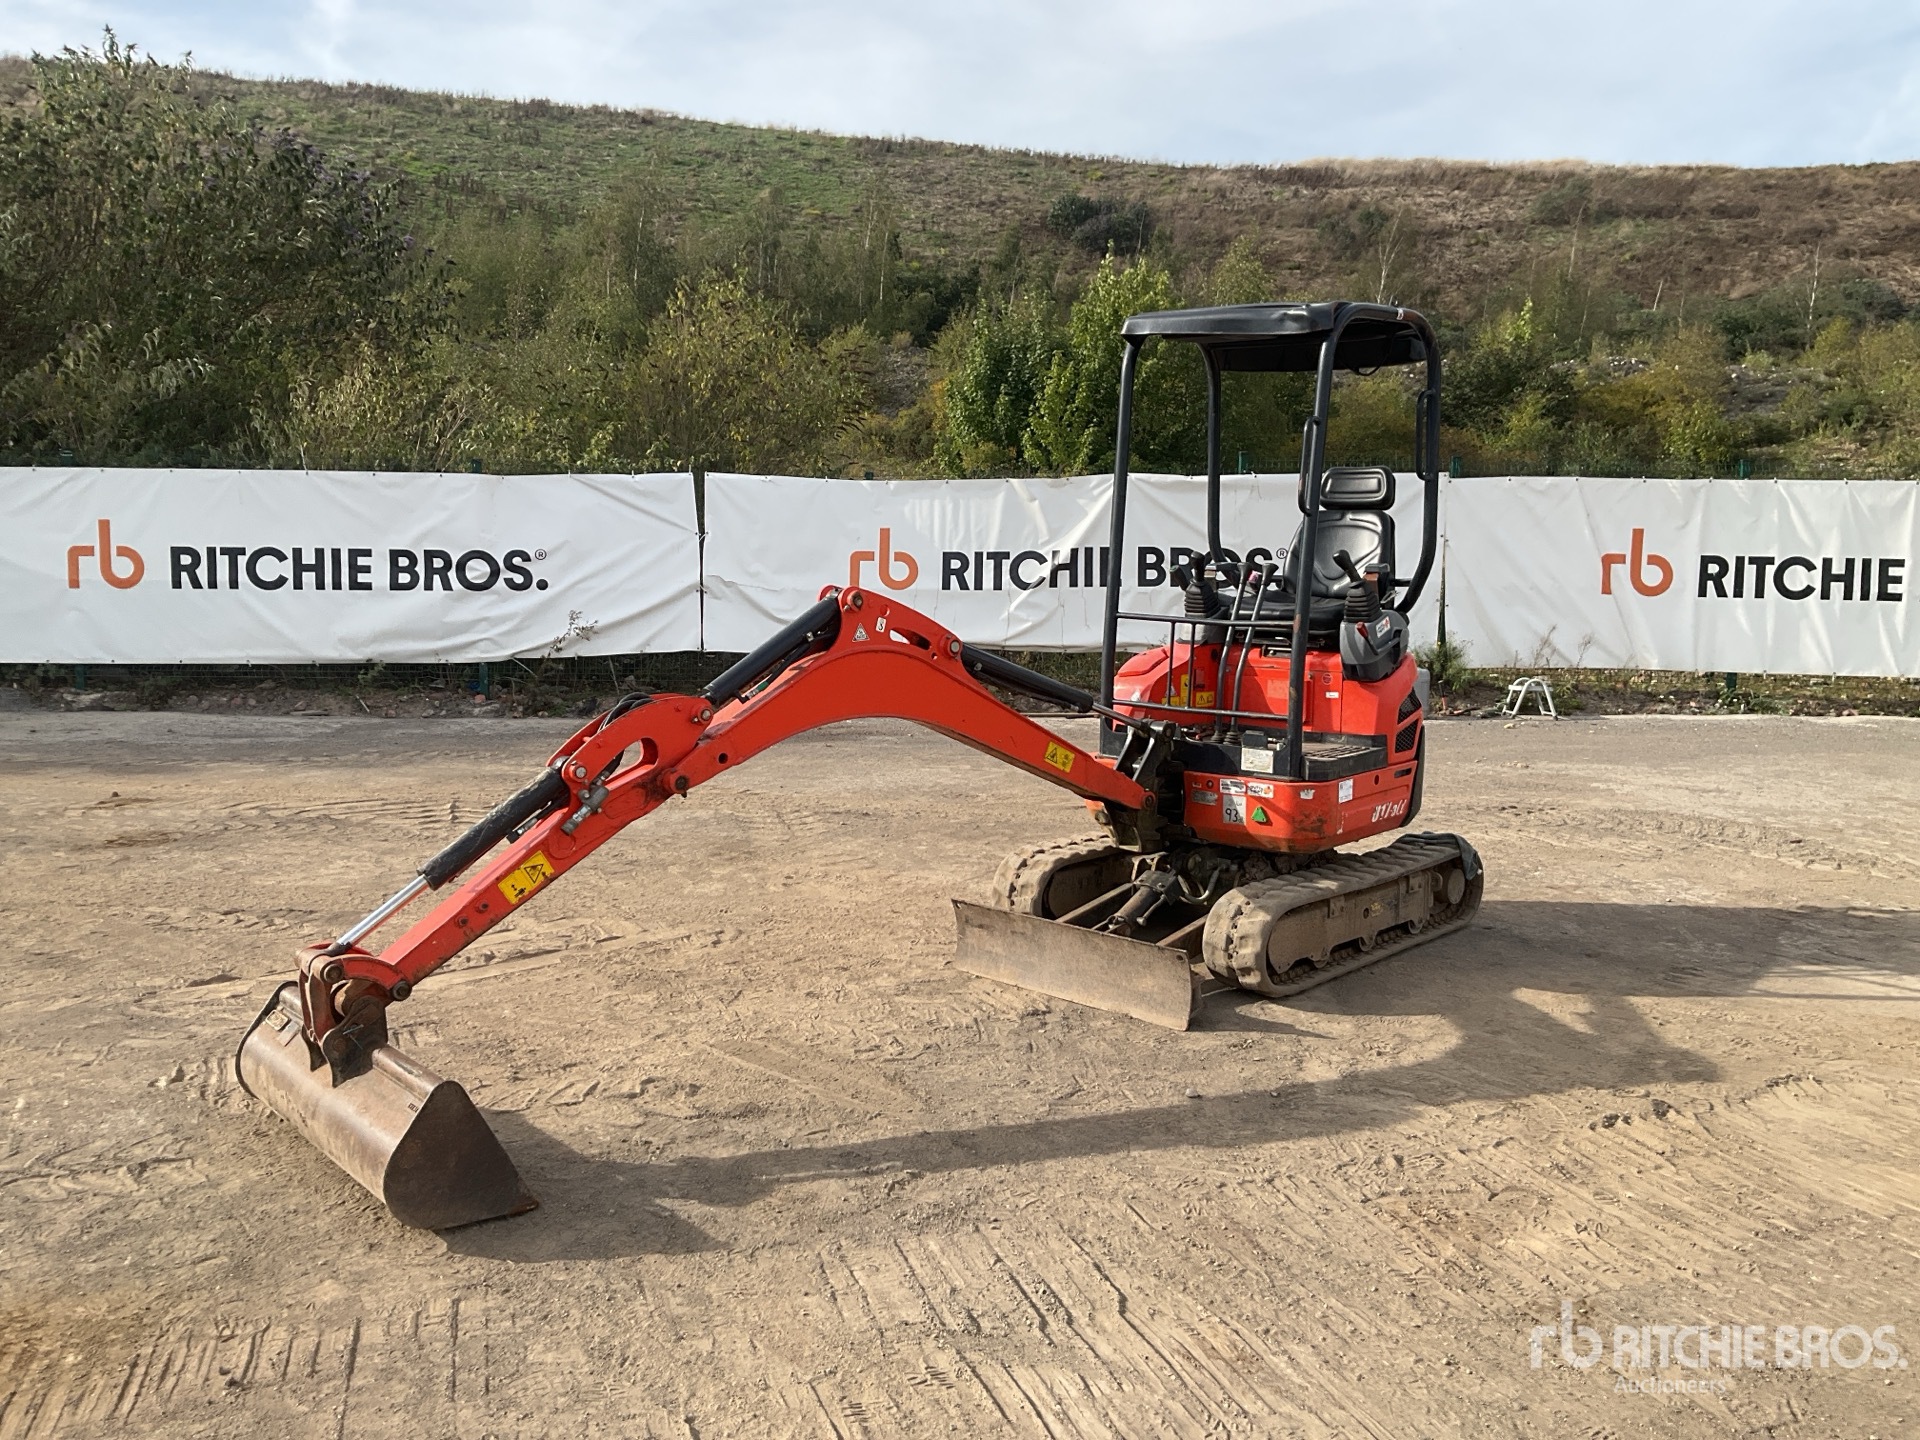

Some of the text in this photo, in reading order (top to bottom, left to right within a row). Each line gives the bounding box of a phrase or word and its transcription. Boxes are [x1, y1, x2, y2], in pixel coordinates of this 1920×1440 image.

[67, 518, 145, 589] rb
[170, 546, 373, 591] RITCHIE
[1601, 528, 1906, 602] rb RITCHIE
